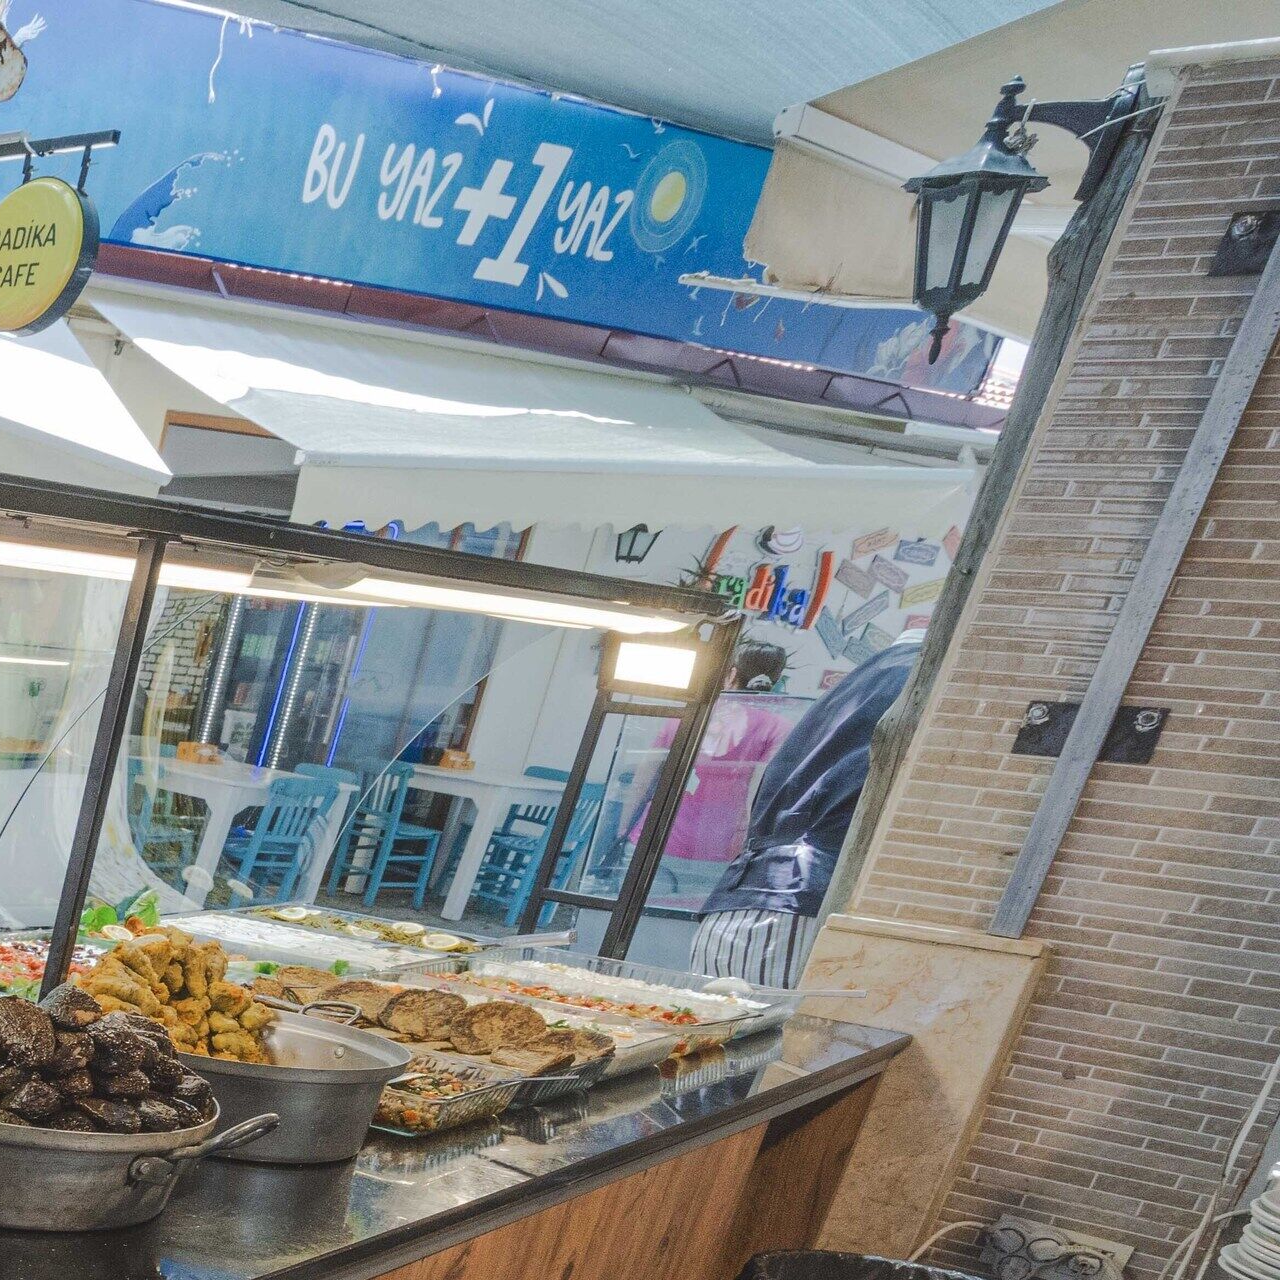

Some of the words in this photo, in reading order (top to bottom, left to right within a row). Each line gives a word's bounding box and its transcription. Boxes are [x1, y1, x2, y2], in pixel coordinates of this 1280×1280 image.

[302, 123, 366, 210] BU
[377, 143, 464, 229] YAZ
[553, 180, 635, 262] YAZ
